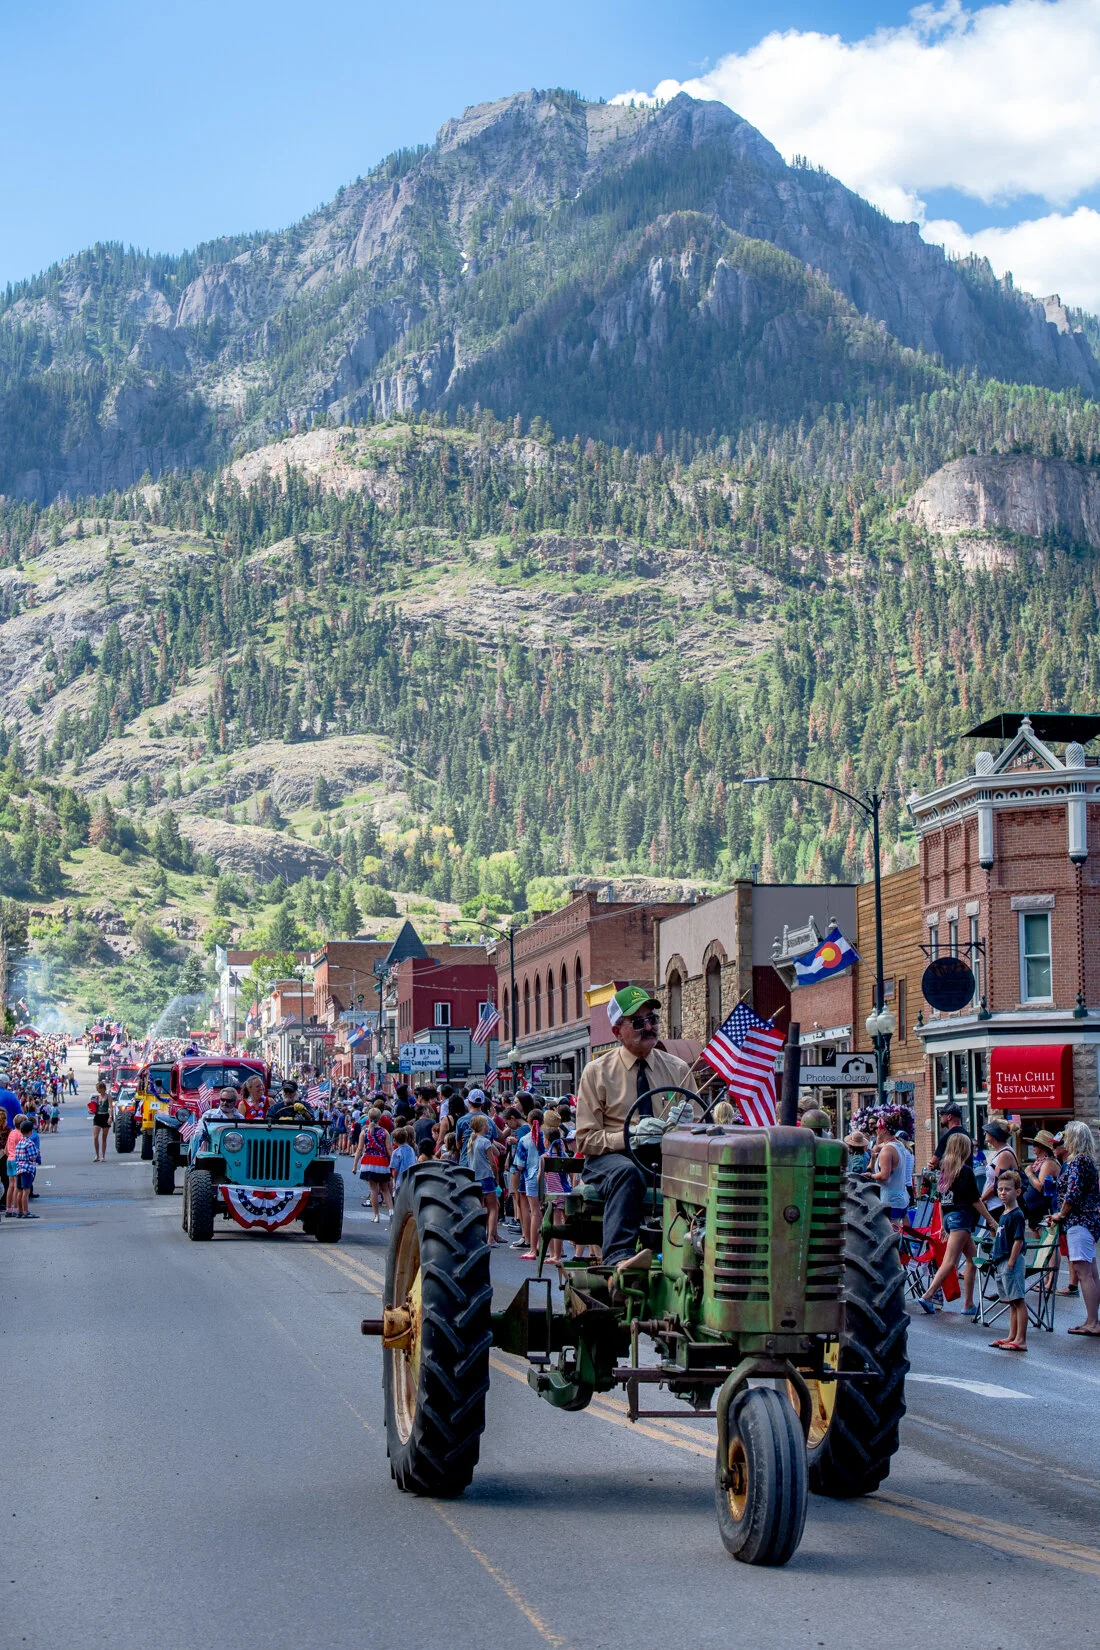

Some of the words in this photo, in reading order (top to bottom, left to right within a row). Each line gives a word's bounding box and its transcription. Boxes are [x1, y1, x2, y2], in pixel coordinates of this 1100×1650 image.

[1013, 752, 1034, 768] 1898
[411, 1059, 441, 1067] Campground
[995, 1072, 1022, 1082] THAI
[1025, 1071, 1055, 1082] CHILI
[996, 1083, 1056, 1094] RESTAURANT
